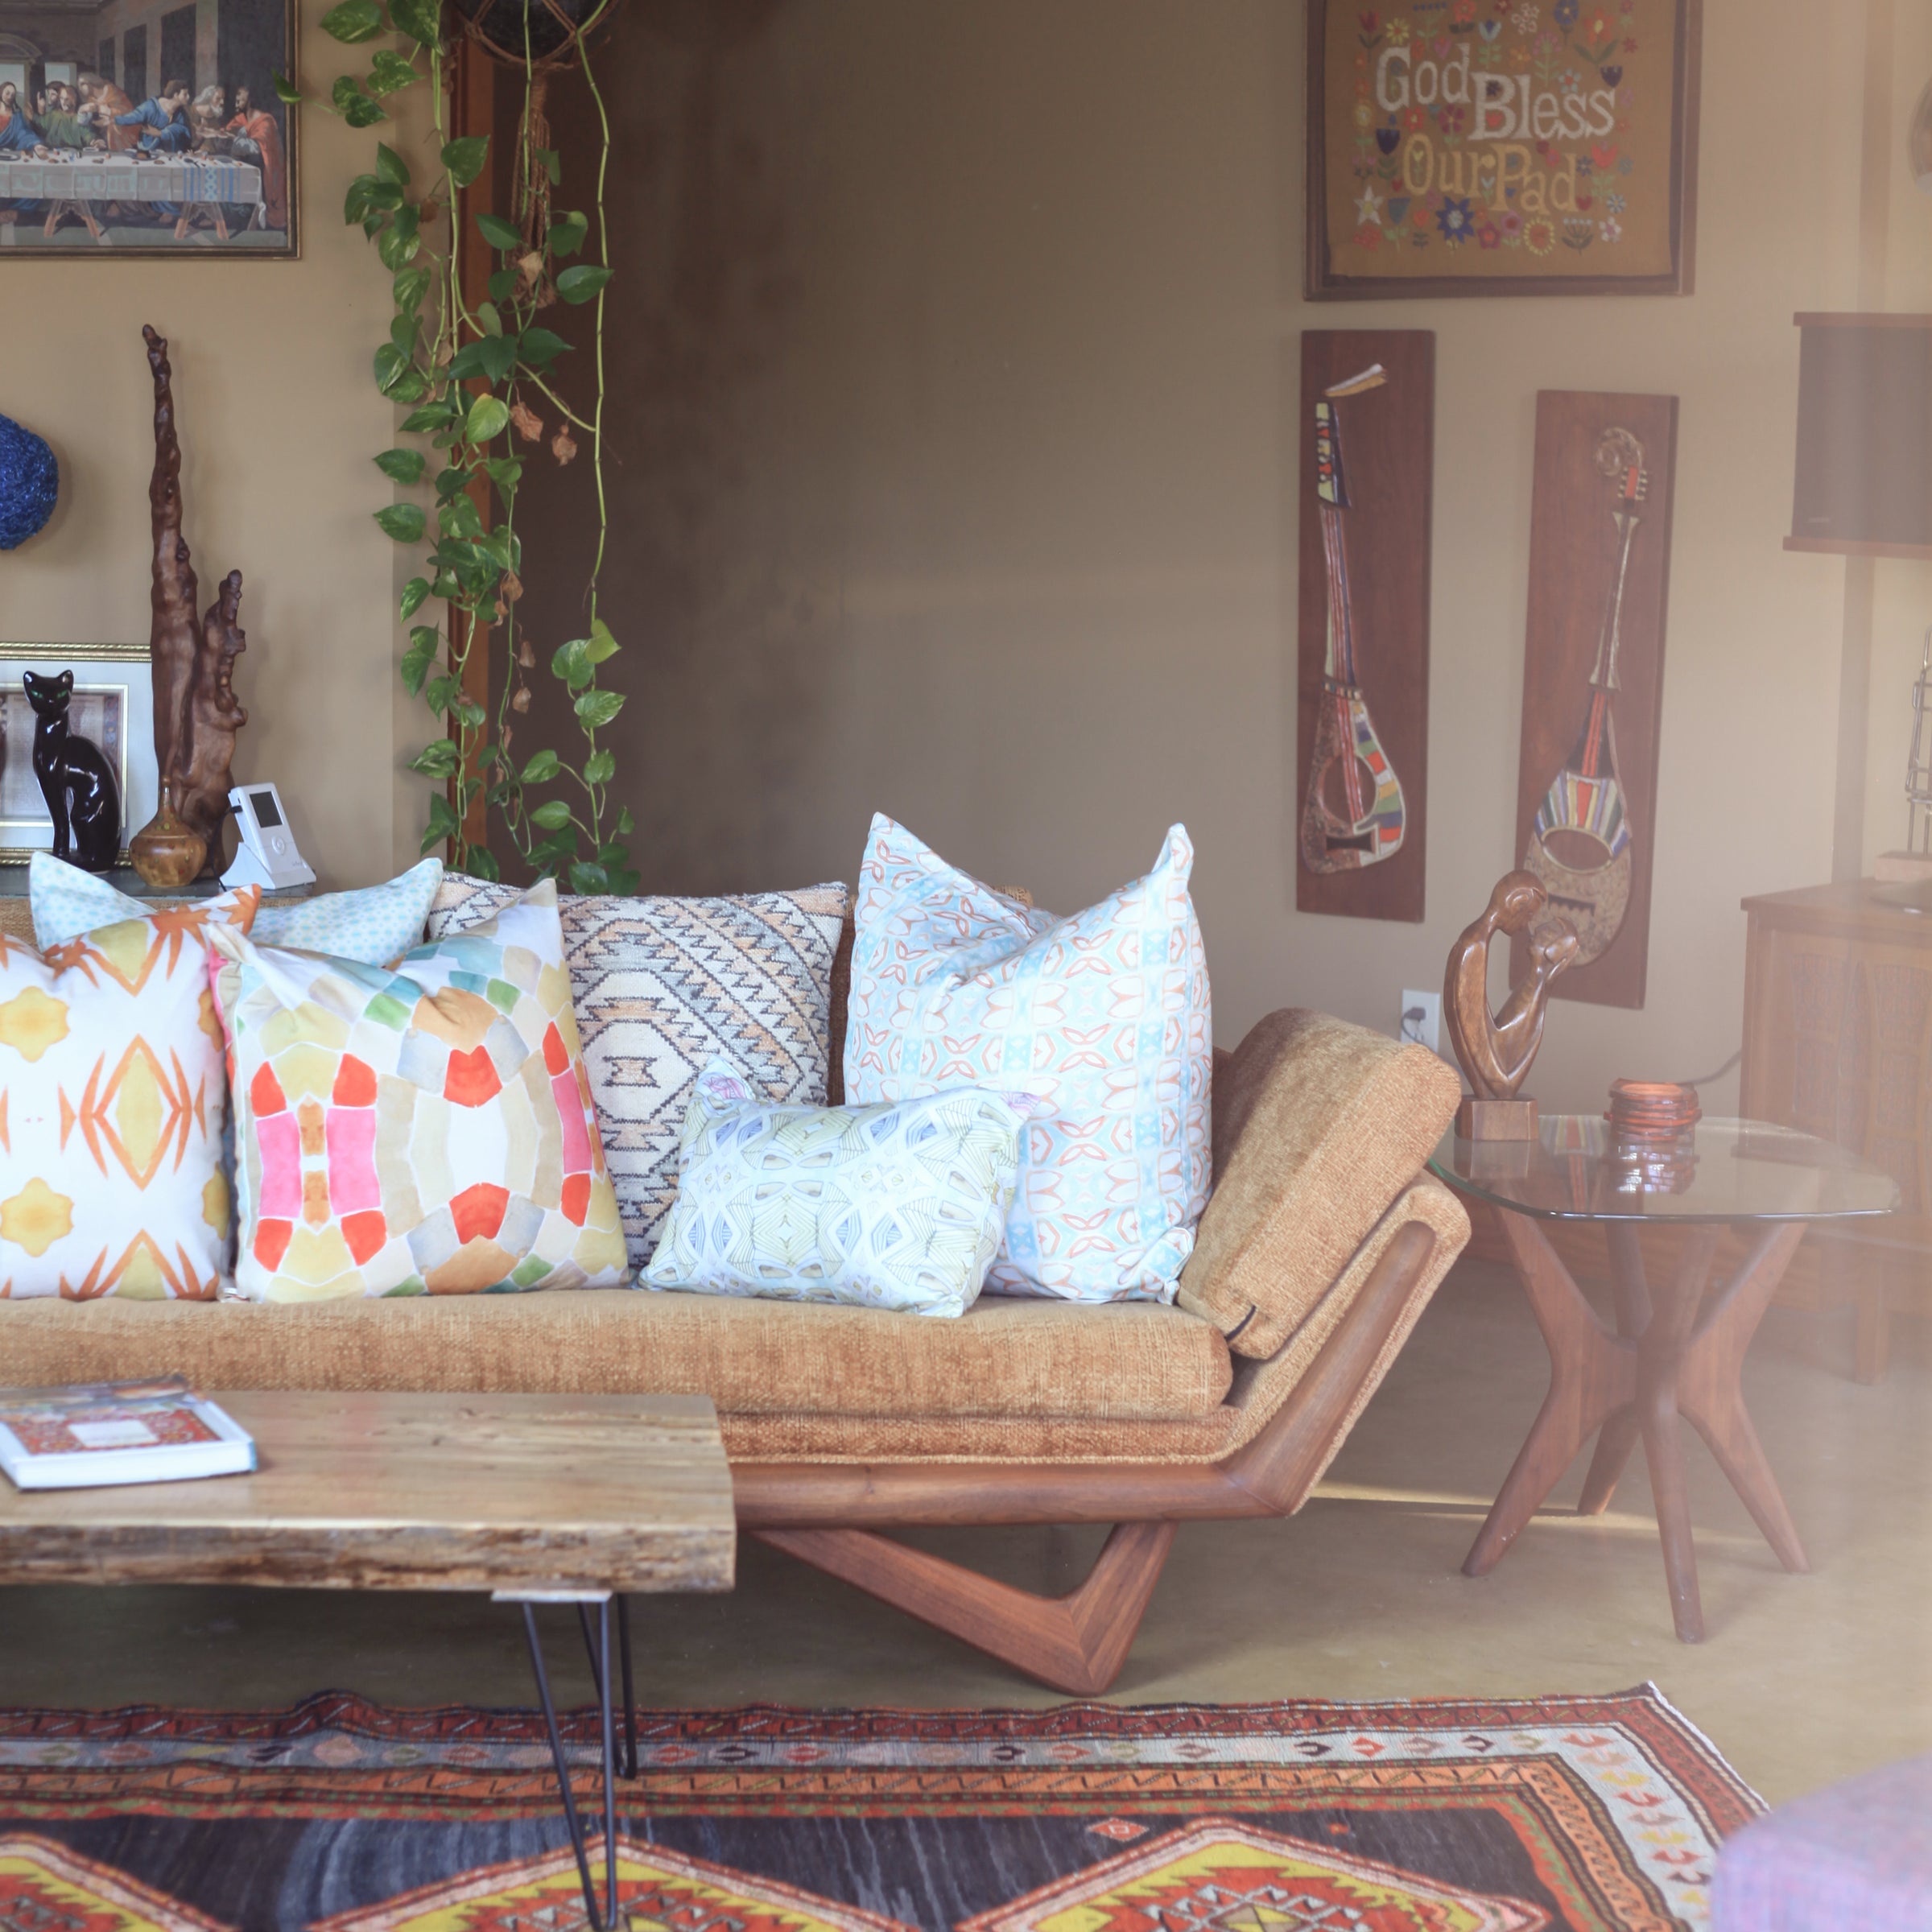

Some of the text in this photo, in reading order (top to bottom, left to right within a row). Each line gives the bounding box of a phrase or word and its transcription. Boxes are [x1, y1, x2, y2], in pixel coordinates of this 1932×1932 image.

[1376, 43, 1616, 140] God Bless
[1403, 133, 1579, 216] Our Pad
